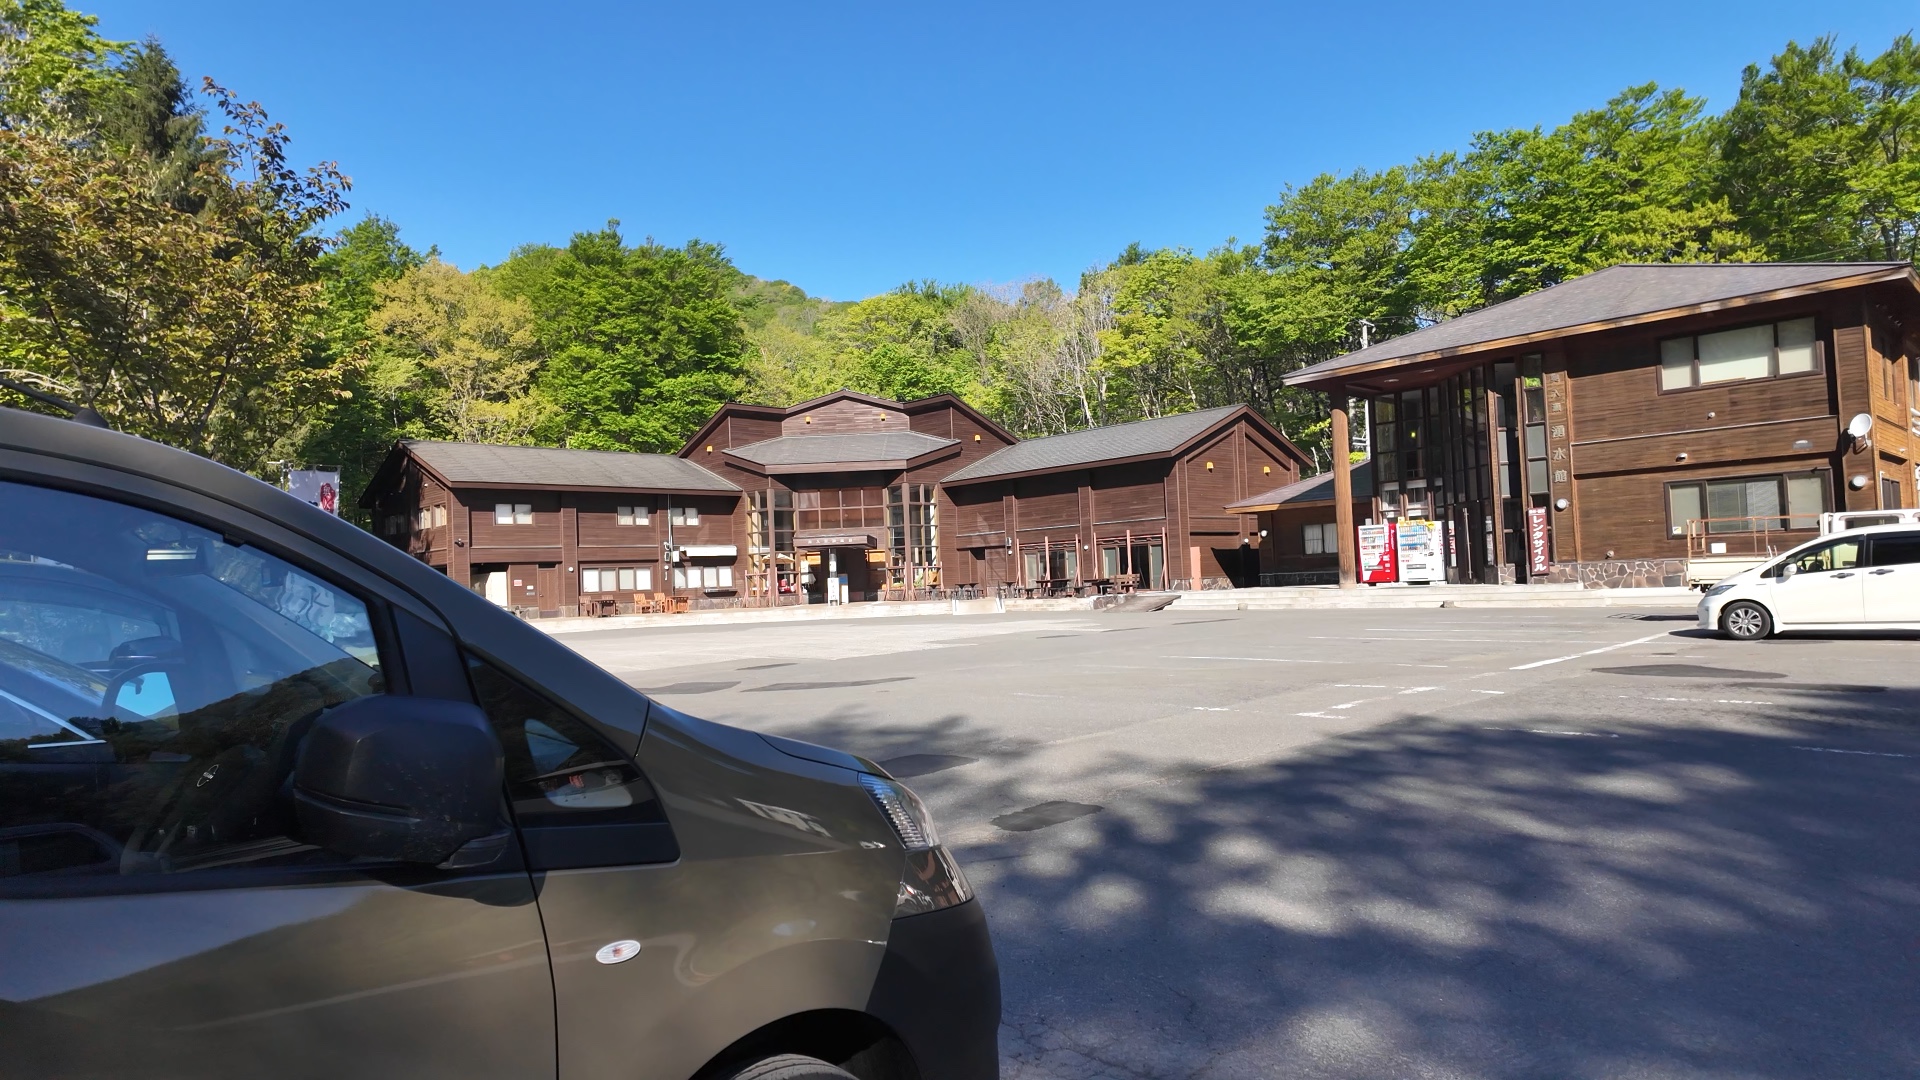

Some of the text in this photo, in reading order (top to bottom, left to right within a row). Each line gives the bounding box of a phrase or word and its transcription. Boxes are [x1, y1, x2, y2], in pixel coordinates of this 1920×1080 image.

[1532, 515, 1547, 572] レンタサイクル
